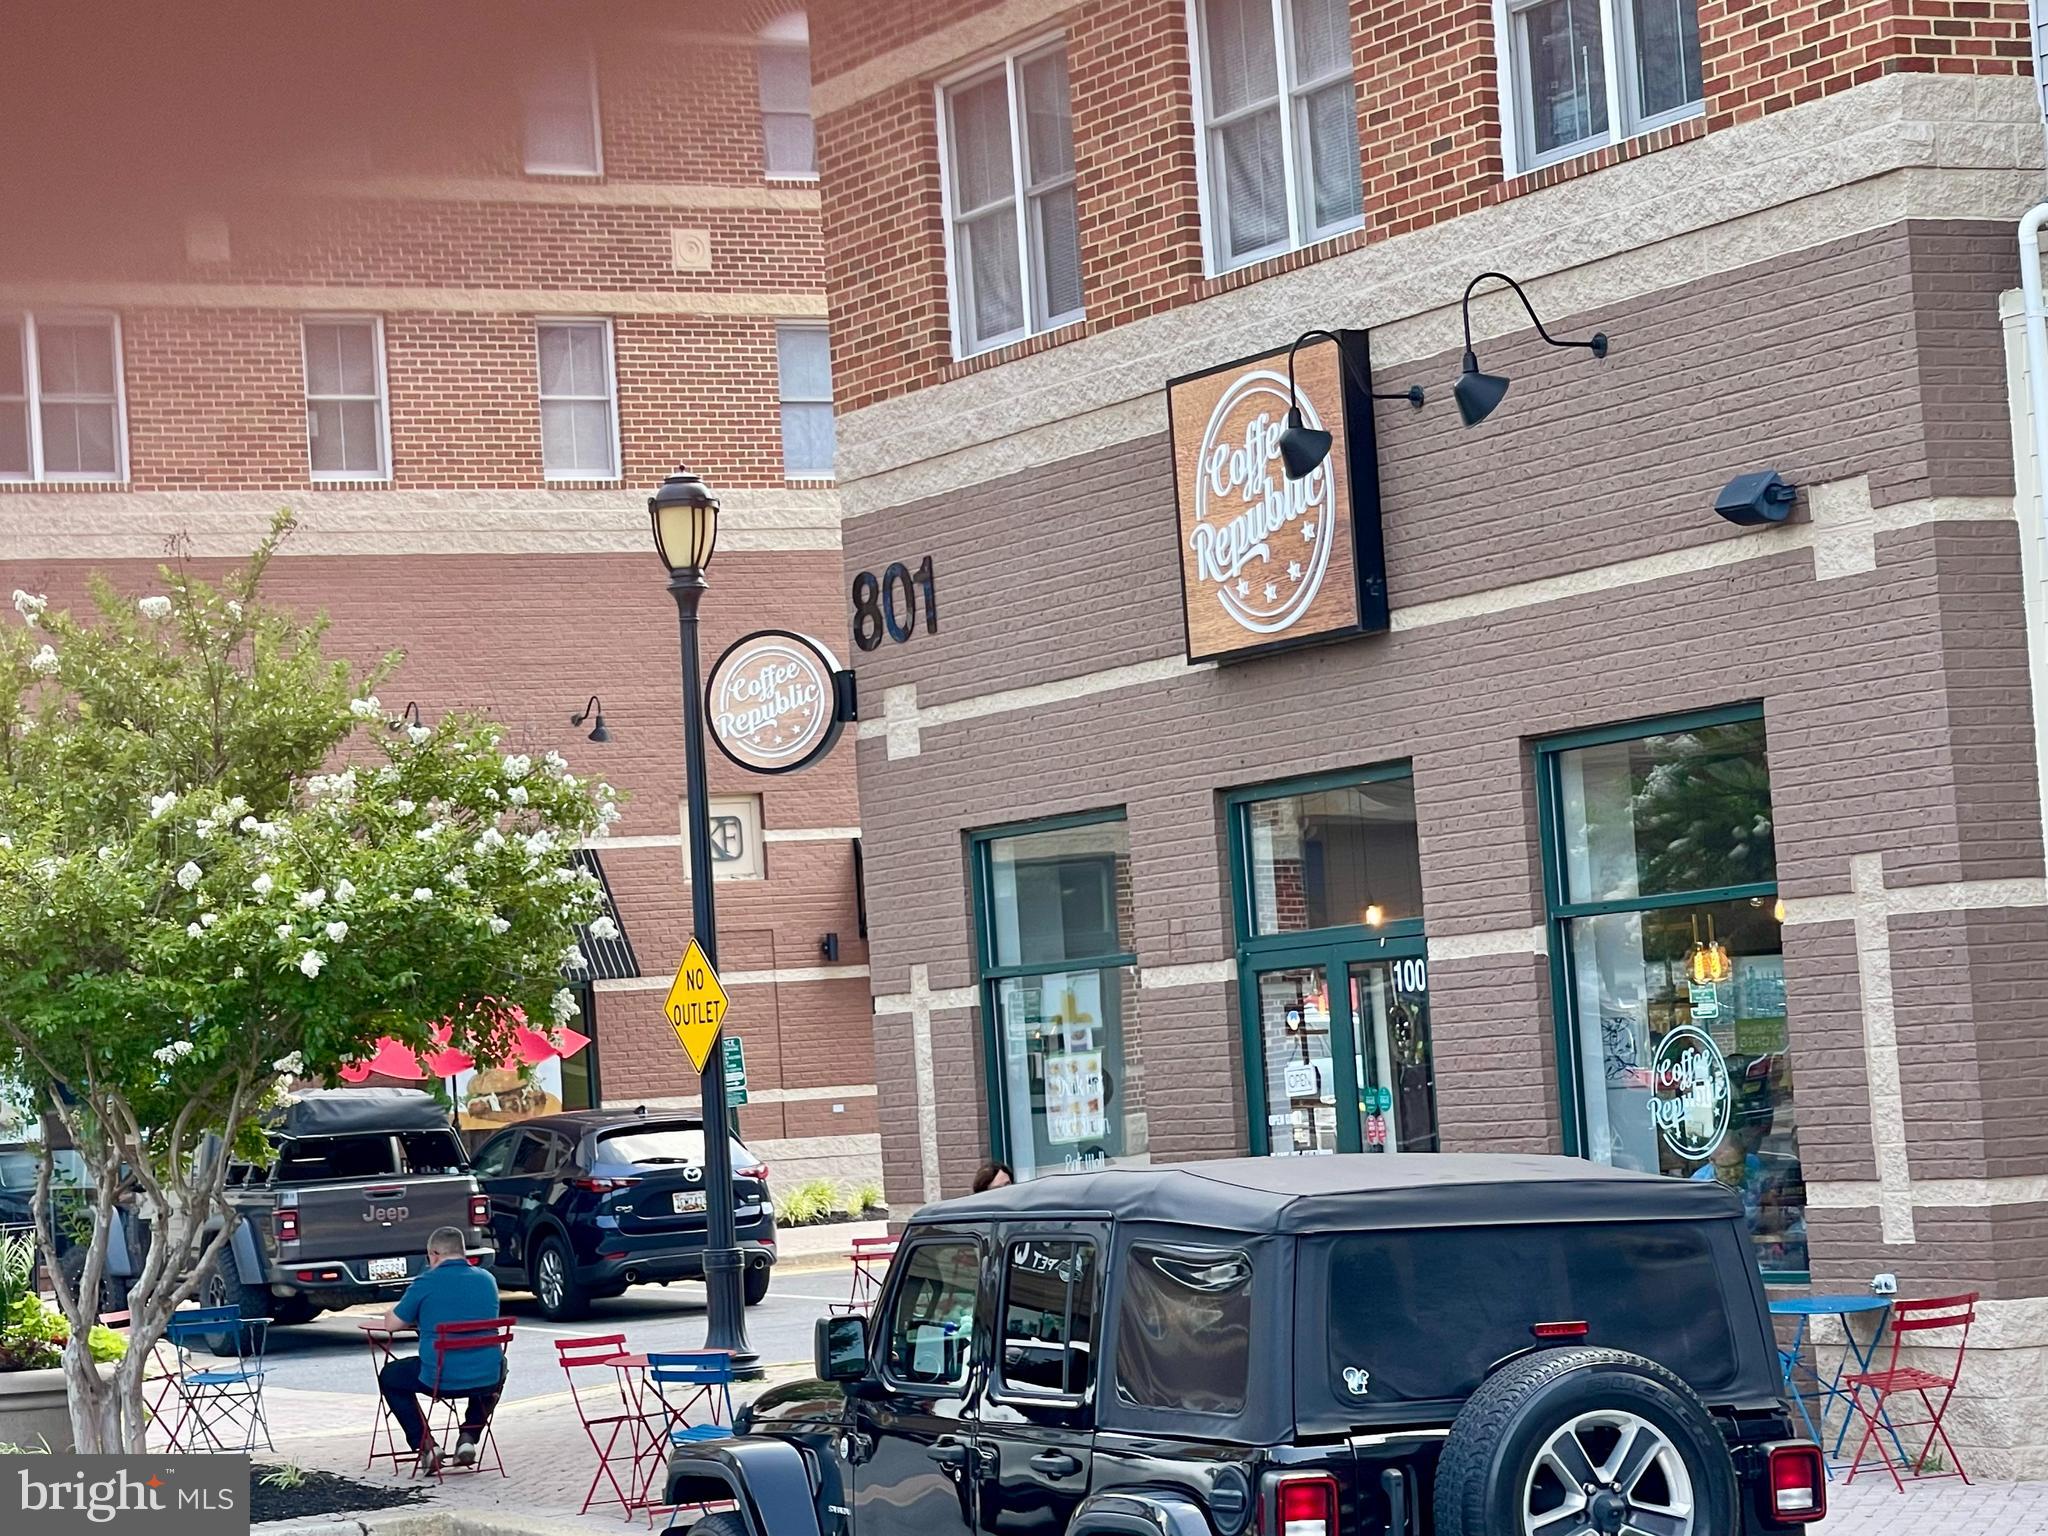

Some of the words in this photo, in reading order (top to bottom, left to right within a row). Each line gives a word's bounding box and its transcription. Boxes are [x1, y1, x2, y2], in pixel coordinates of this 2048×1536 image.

[1190, 465, 1326, 582] Republic
[852, 555, 938, 651] 801
[728, 660, 801, 702] Coffee
[715, 683, 821, 739] Republic
[686, 968, 704, 992] NO
[1393, 958, 1426, 992] 100
[673, 1000, 720, 1027] OUTLET
[1657, 1047, 1713, 1091] Coffee
[362, 1204, 409, 1222] Jeep
